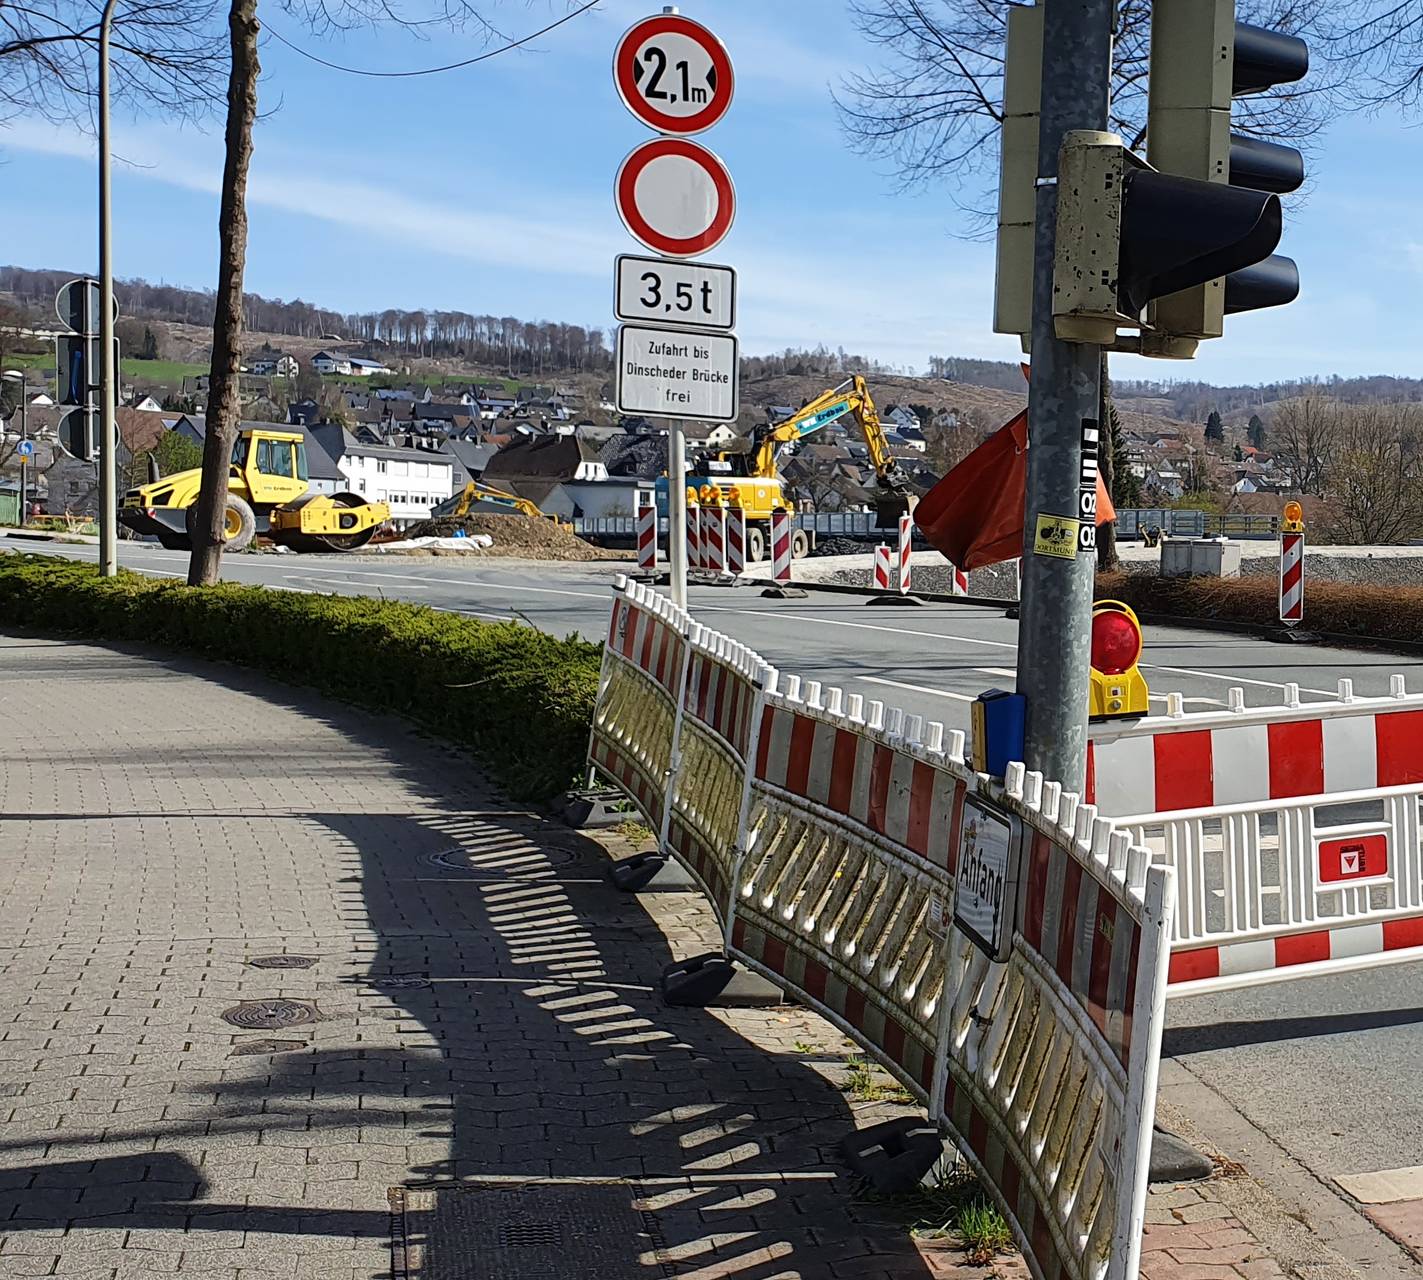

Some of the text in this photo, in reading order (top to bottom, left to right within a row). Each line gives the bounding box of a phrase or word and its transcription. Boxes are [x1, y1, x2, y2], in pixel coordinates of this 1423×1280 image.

[648, 341, 710, 360] Zufahrt bis
[626, 362, 729, 384] Dinscheder Brücke
[665, 389, 691, 403] frei
